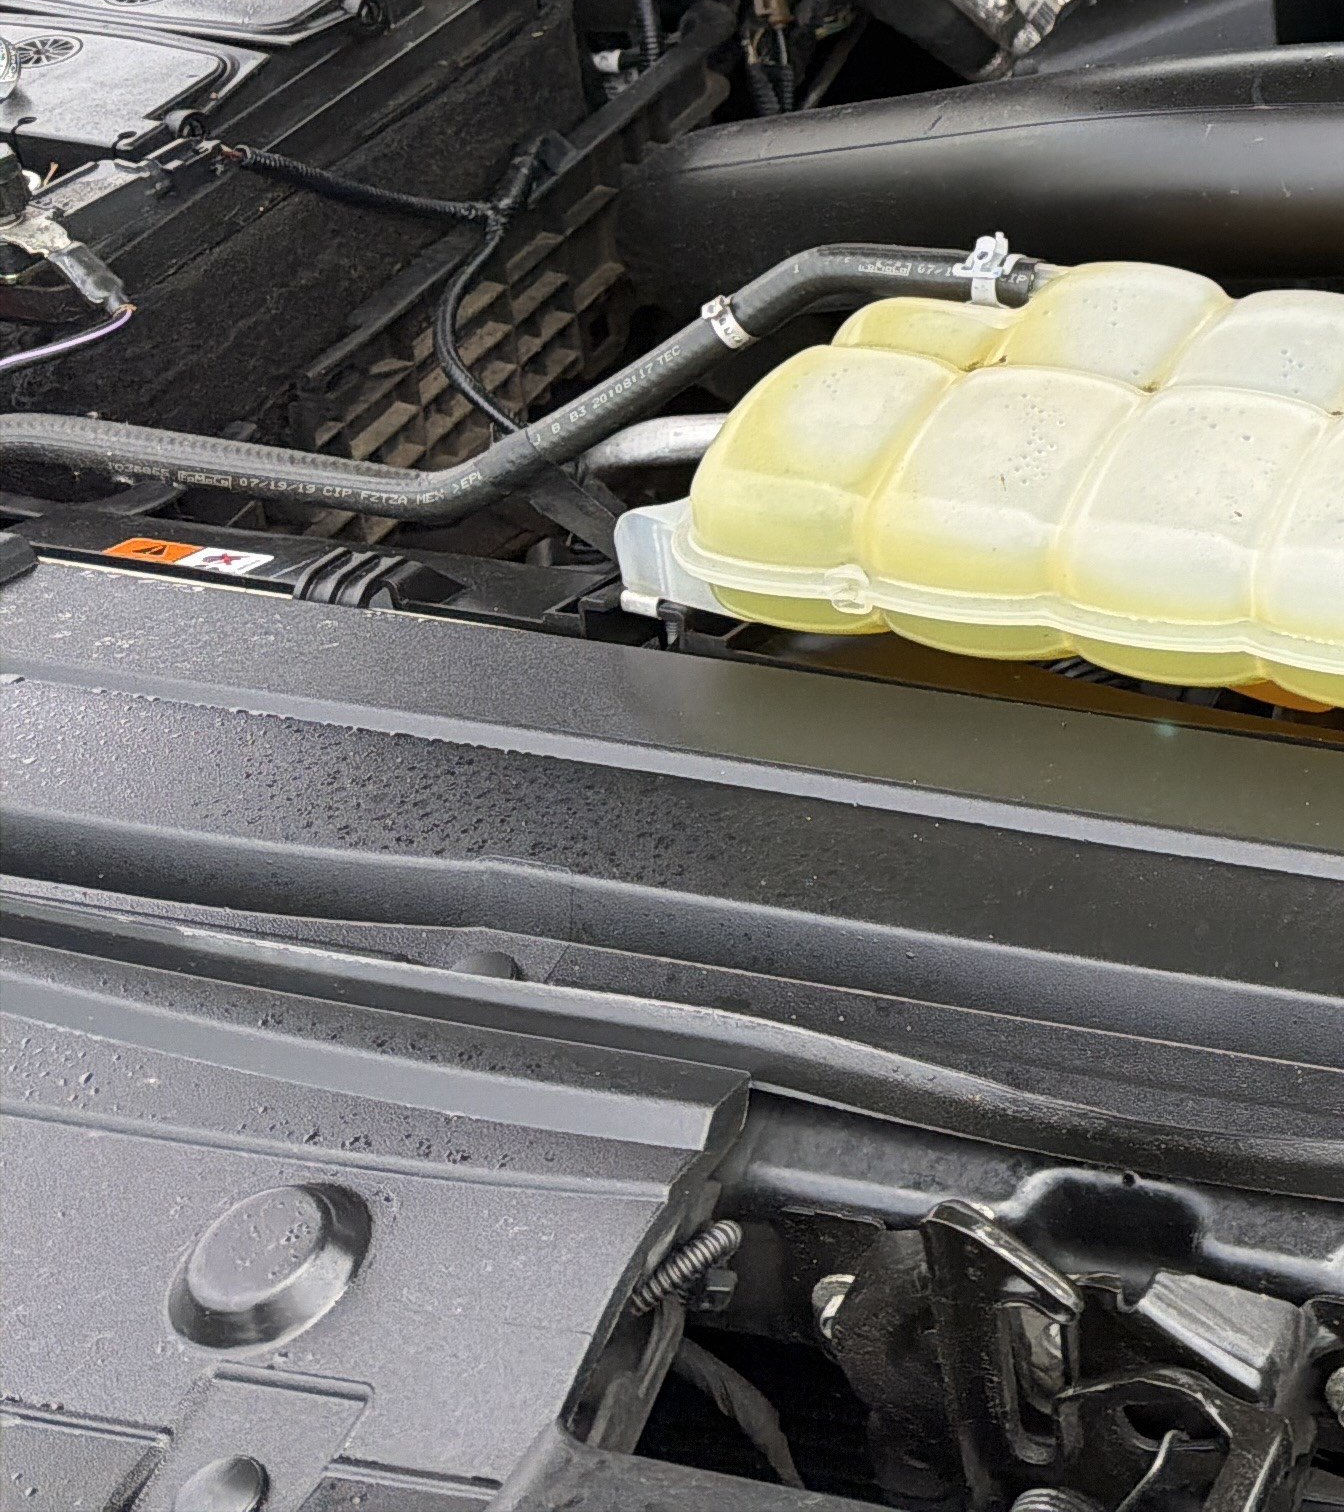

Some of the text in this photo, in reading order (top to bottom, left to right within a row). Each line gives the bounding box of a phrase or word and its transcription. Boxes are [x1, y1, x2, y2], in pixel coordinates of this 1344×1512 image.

[657, 345, 681, 364] TEC
[239, 478, 316, 494] 07/19/19
[322, 487, 353, 499] CIP
